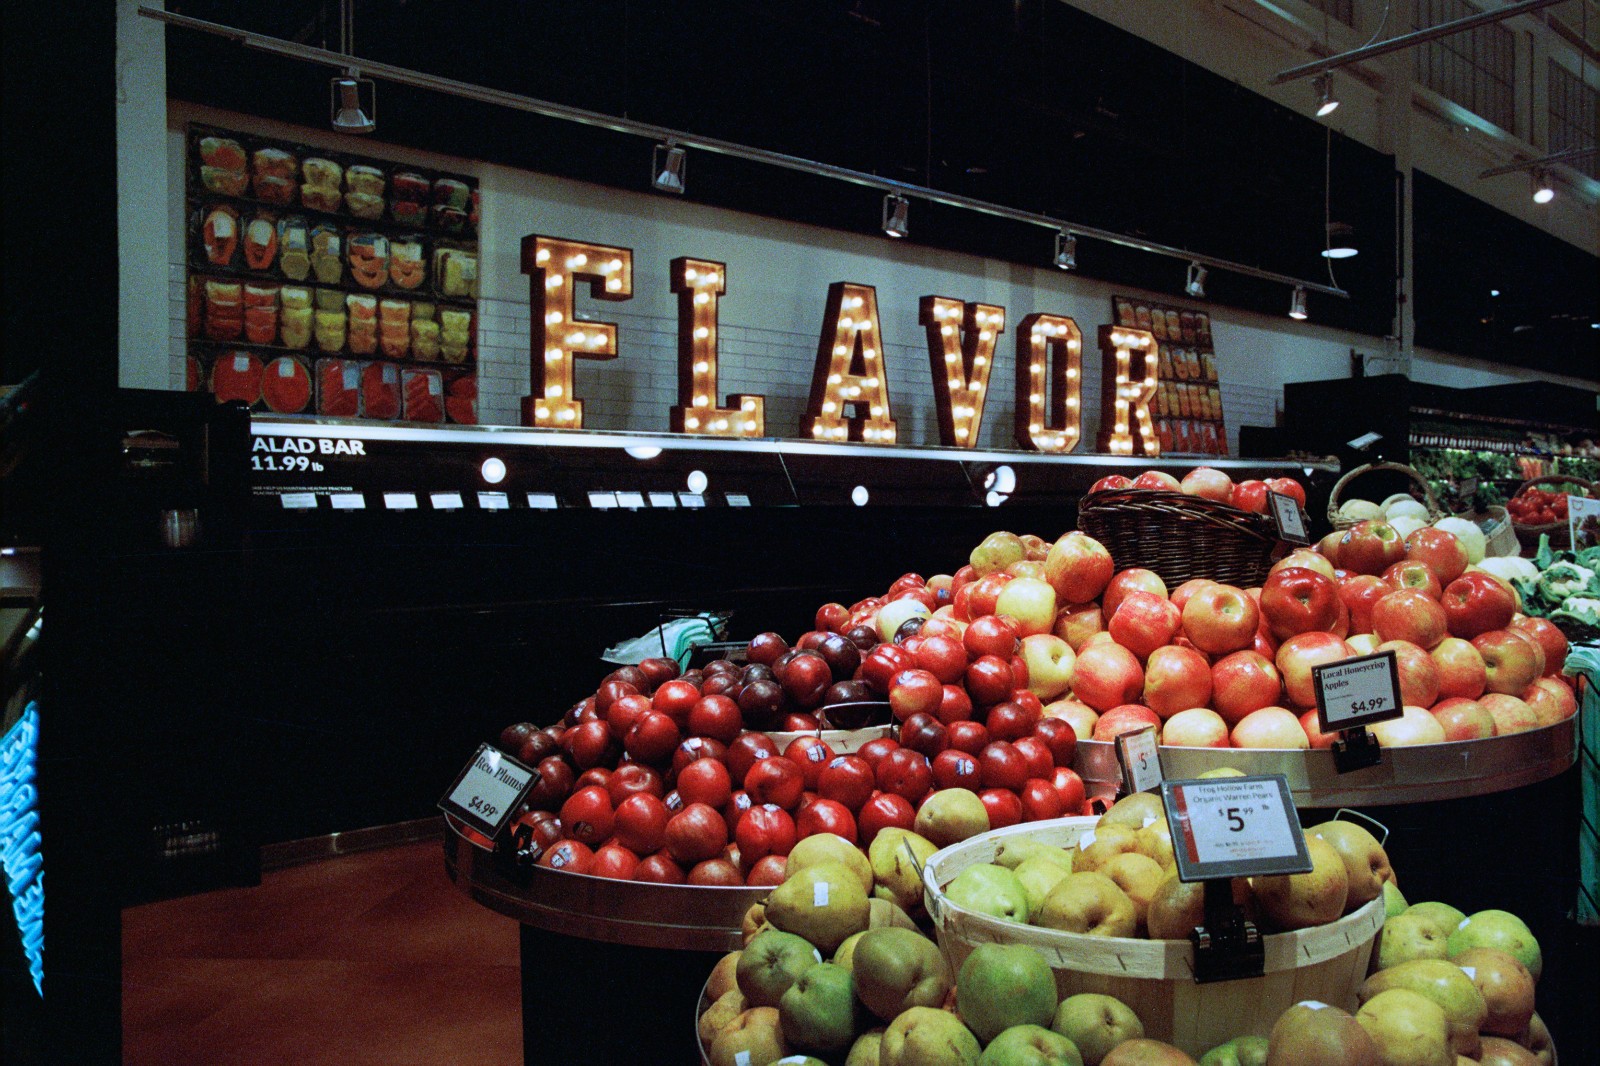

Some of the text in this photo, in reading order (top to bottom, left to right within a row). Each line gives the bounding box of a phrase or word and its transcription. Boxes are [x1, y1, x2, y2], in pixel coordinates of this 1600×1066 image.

[521, 234, 1160, 457] FLAVOR
[252, 437, 366, 455] ALAD BAR
[251, 455, 324, 472] 11.99 lb
[1322, 661, 1386, 679] Local Honeycrisp
[1324, 680, 1349, 691] Apples
[1351, 698, 1384, 714] $4.99
[493, 767, 525, 791] Plums
[1199, 785, 1216, 793] Frog
[1216, 784, 1243, 792] Hollow
[1224, 793, 1251, 801] Warren
[468, 796, 496, 817] $4.99
